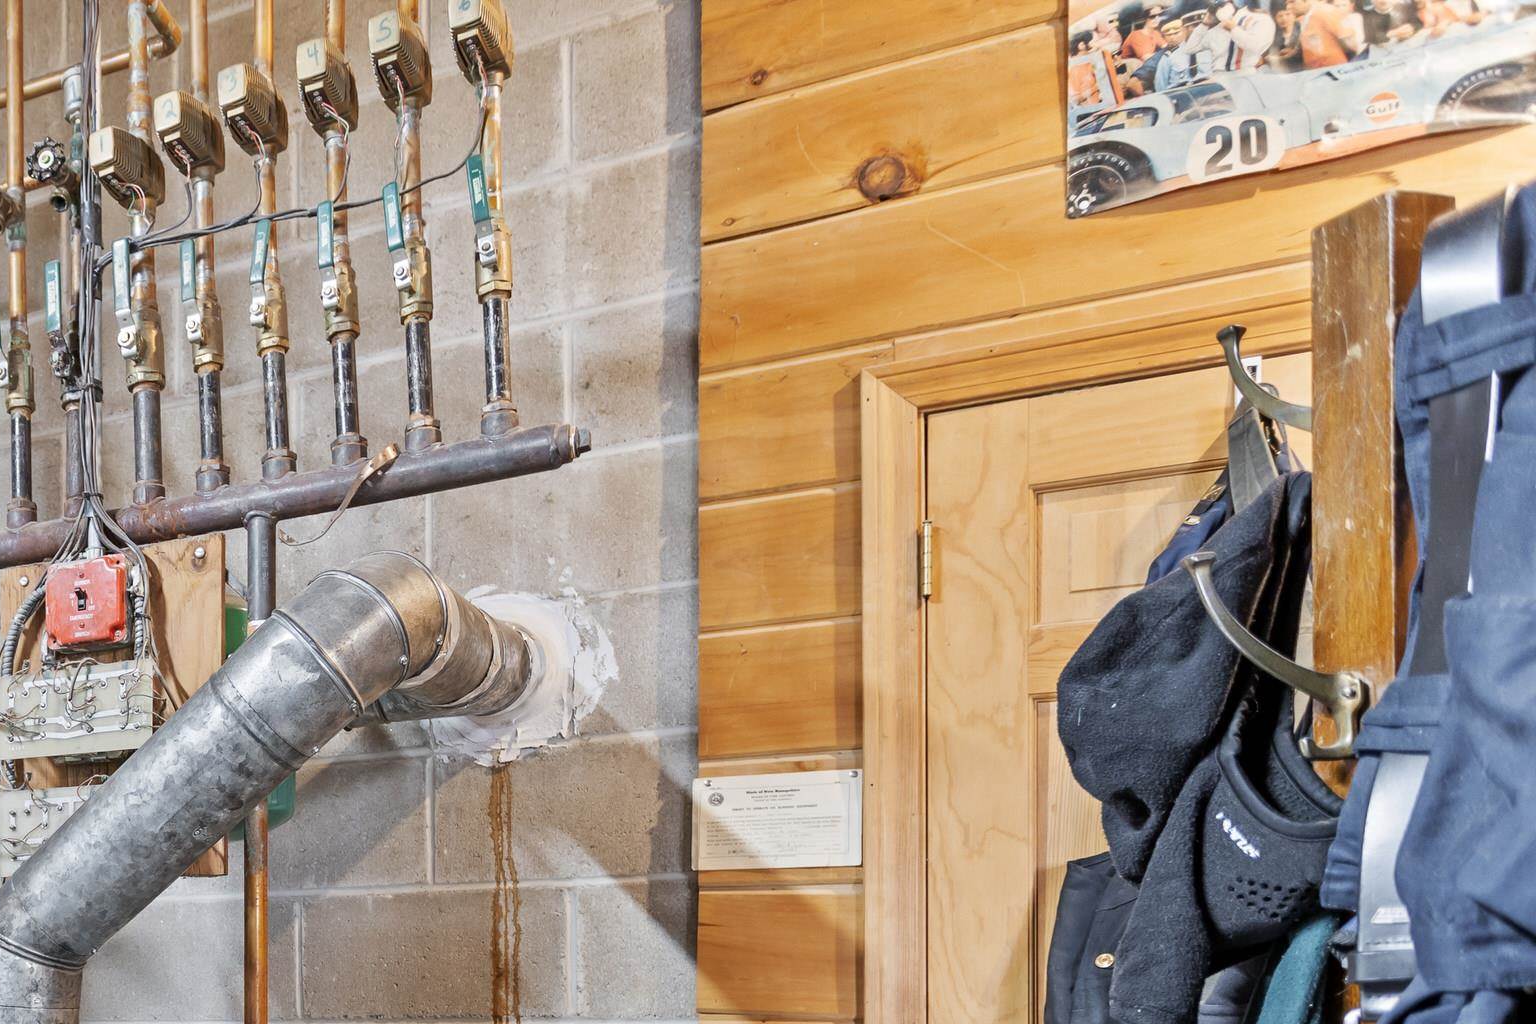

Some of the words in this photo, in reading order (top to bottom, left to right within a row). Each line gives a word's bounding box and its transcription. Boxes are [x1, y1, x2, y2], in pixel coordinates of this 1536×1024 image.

[375, 16, 392, 43] 5
[306, 43, 320, 66] 4
[161, 98, 177, 118] 2
[1365, 101, 1401, 116] Gulf
[1204, 118, 1269, 177] 20
